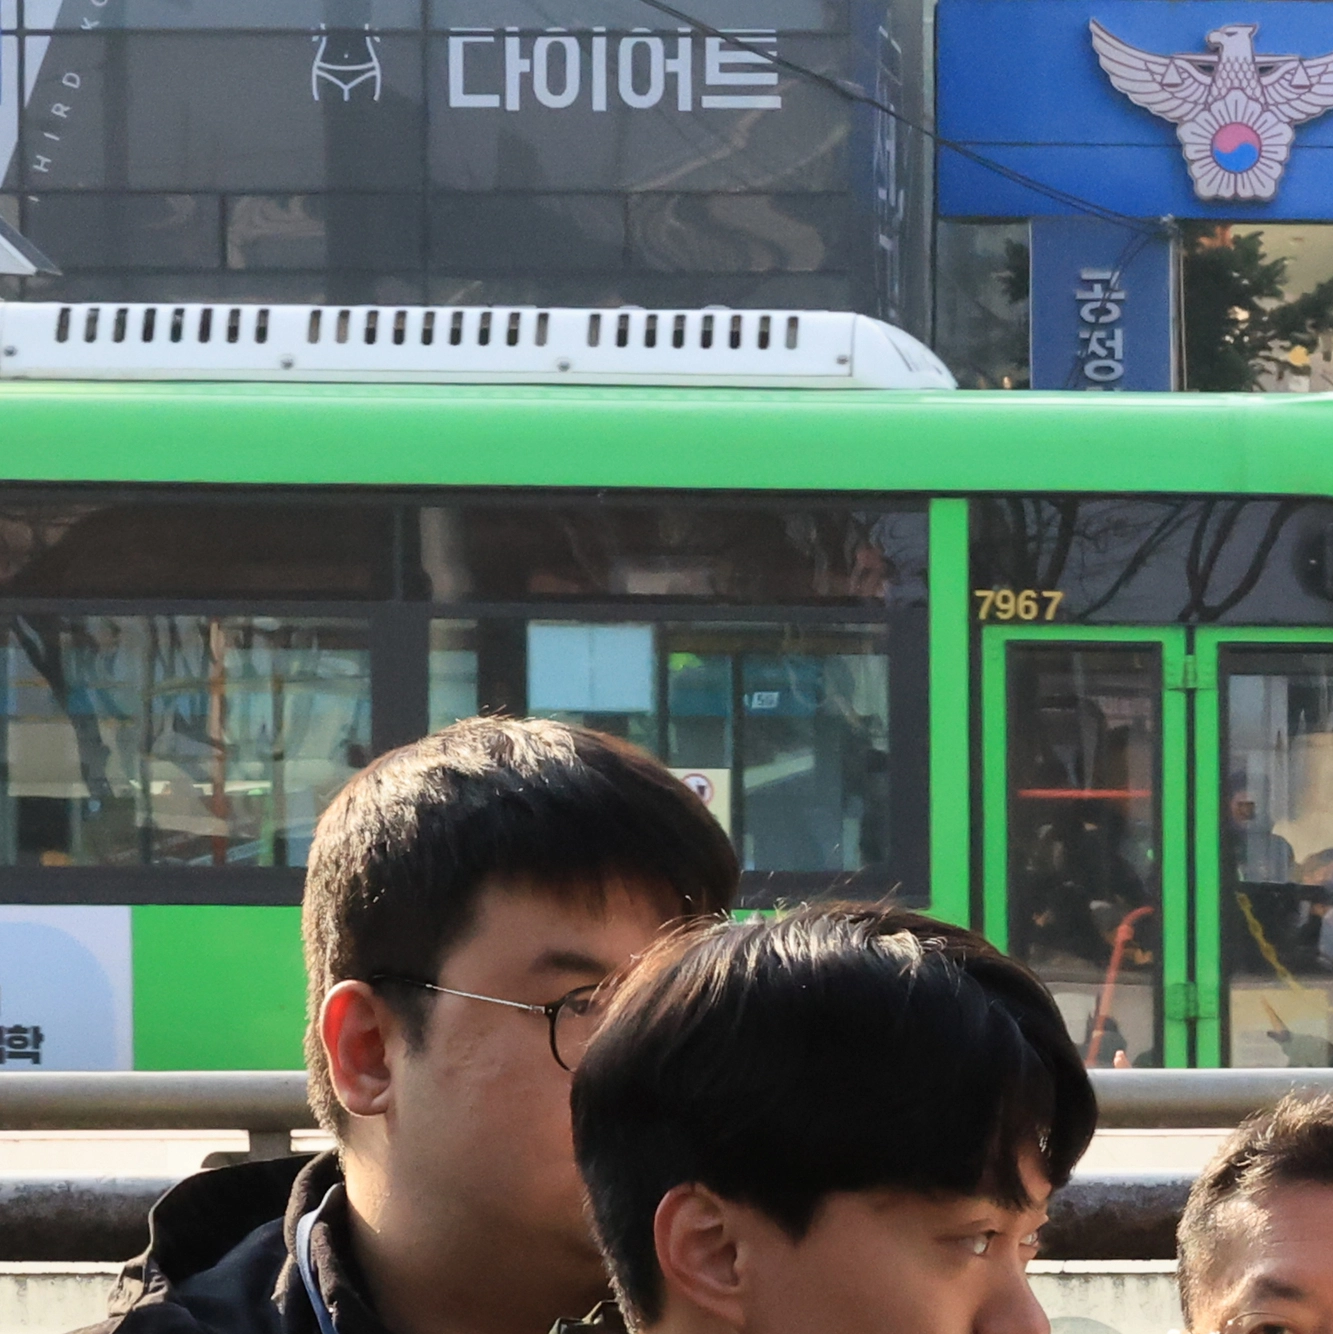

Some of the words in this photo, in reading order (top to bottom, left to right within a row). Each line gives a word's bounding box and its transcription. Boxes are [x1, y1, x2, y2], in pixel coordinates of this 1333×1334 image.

[447, 27, 782, 111] 다이어트
[1075, 269, 1126, 391] 공정
[974, 590, 1065, 622] 7967
[0, 1025, 45, 1065] 학
